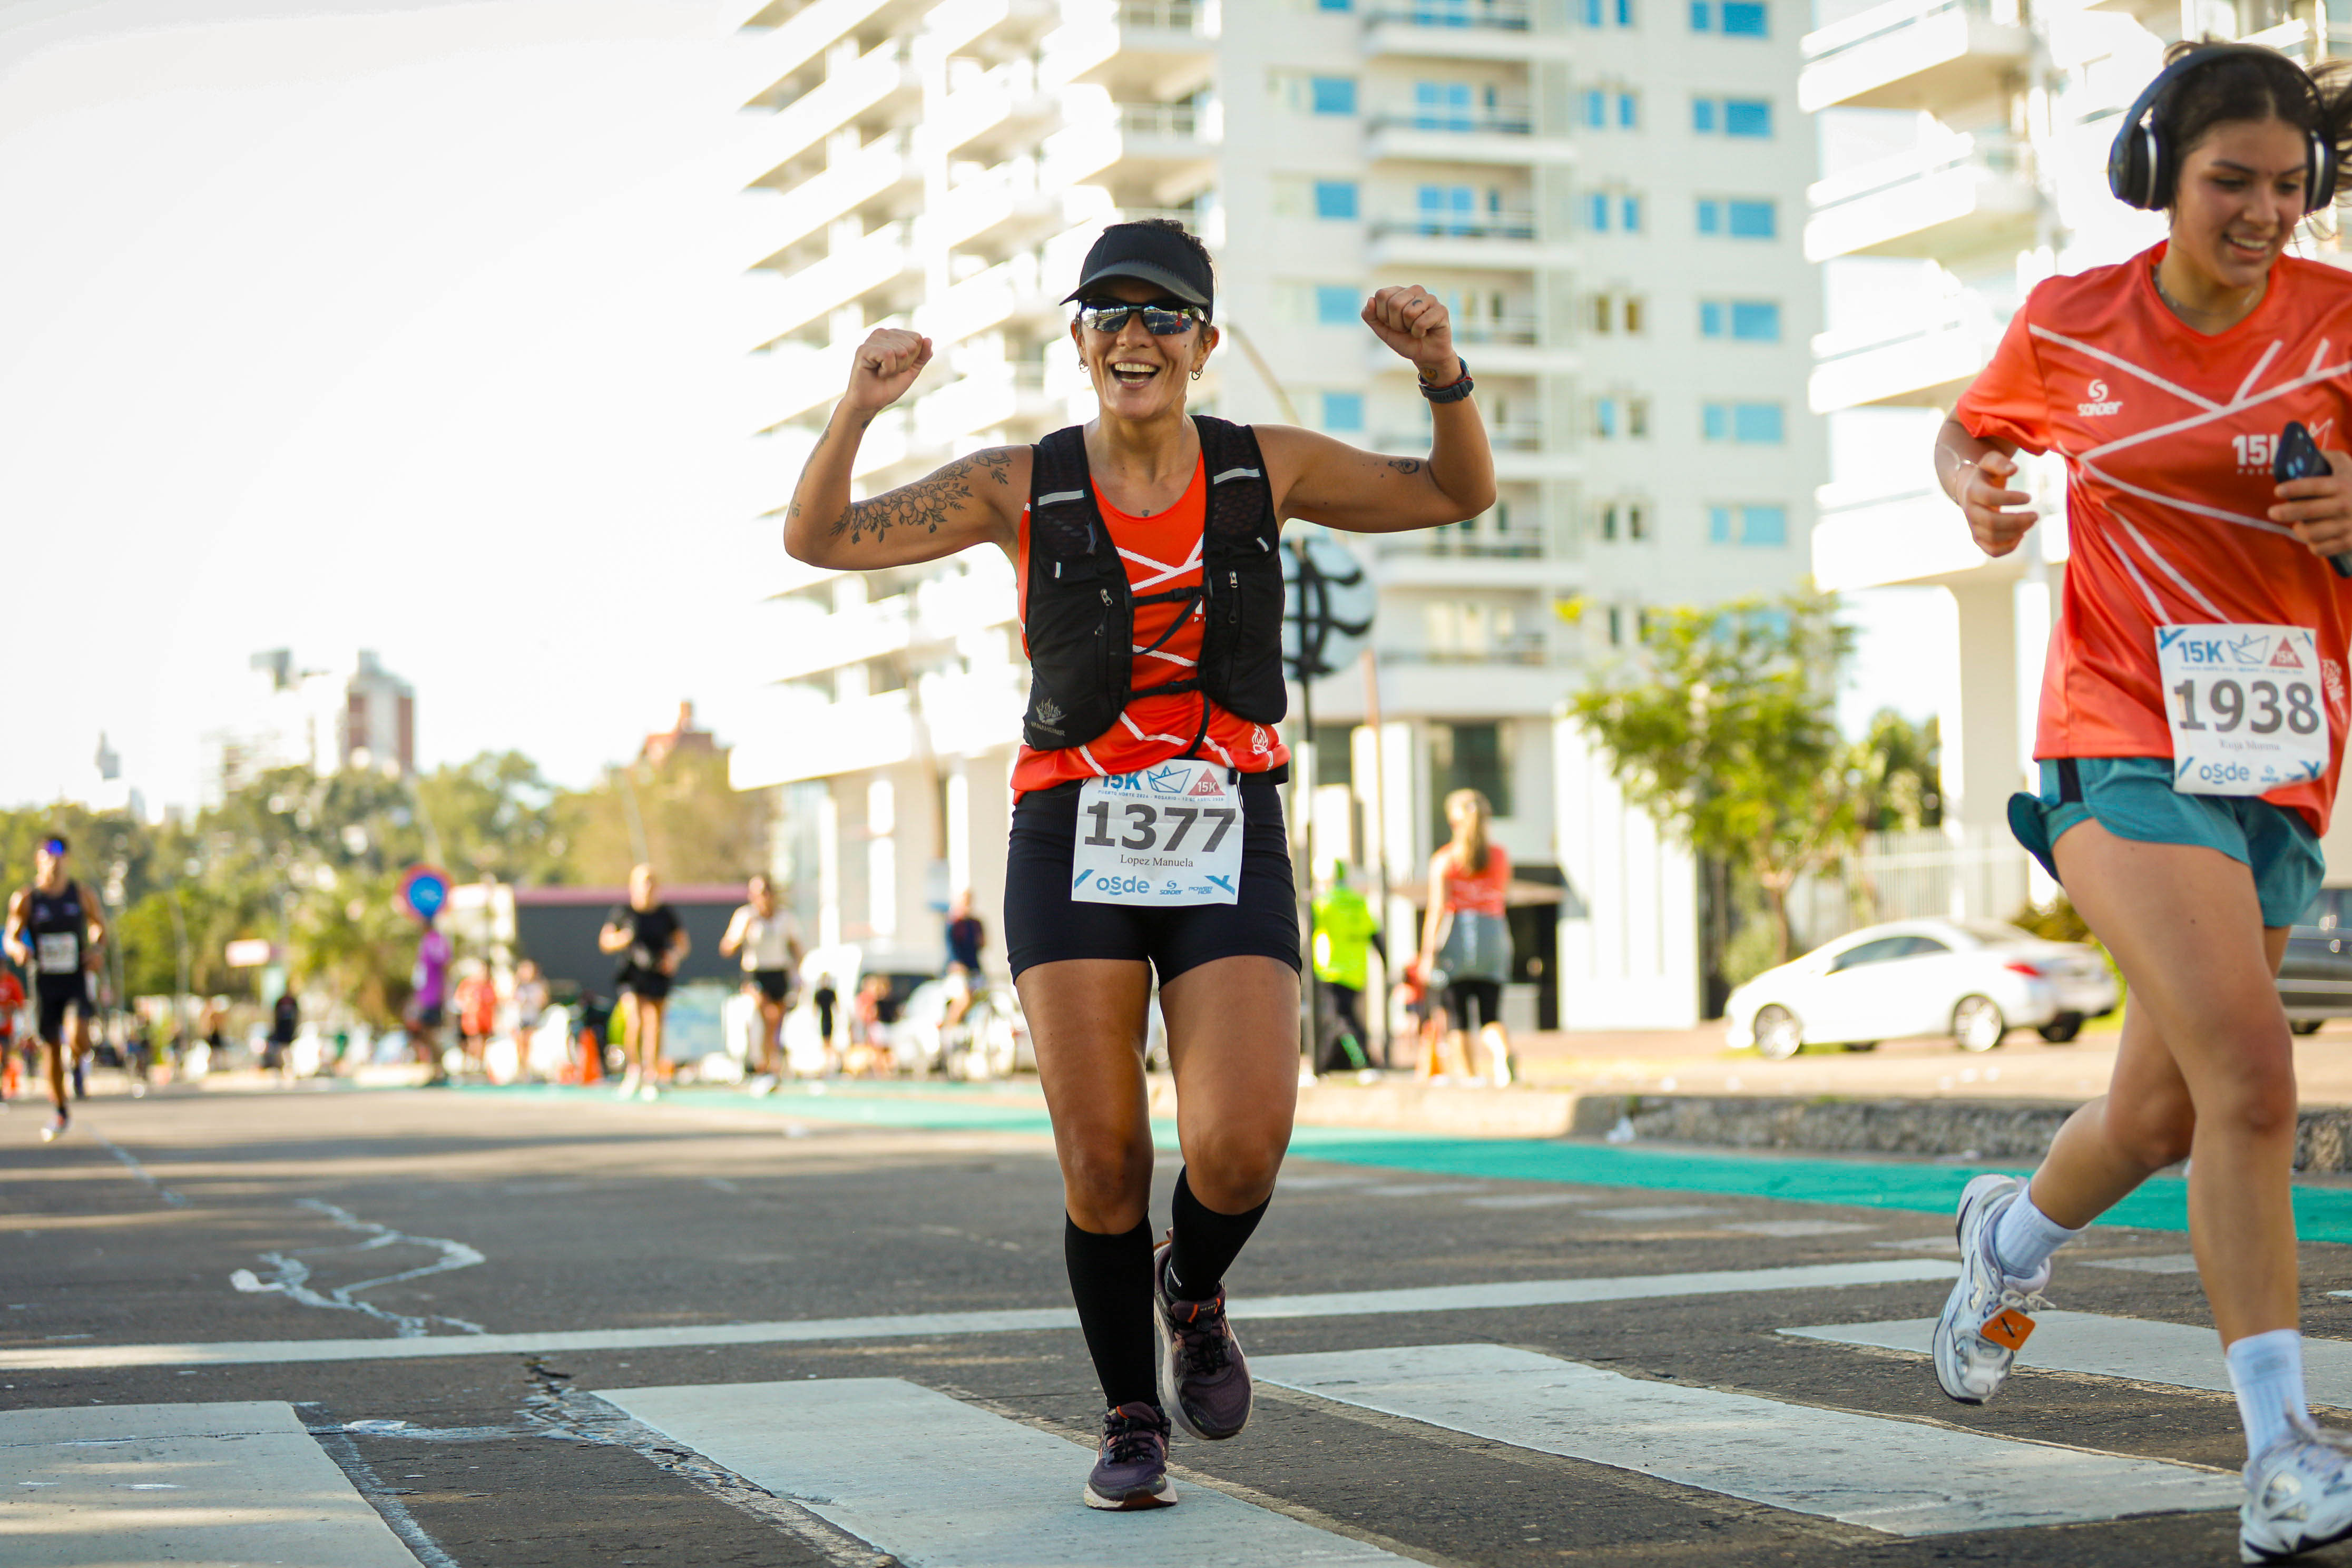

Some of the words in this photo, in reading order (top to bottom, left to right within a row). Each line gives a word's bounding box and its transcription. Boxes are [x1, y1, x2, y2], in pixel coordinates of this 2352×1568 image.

[2178, 641, 2224, 663] 15K
[2174, 679, 2319, 734] 1938
[2200, 762, 2250, 782] osde
[1198, 781, 1217, 793] 15K
[1085, 801, 1236, 852] 1377
[1120, 854, 1150, 866] Lopez
[1153, 857, 1193, 867] Manuela
[1096, 876, 1150, 894] osde
